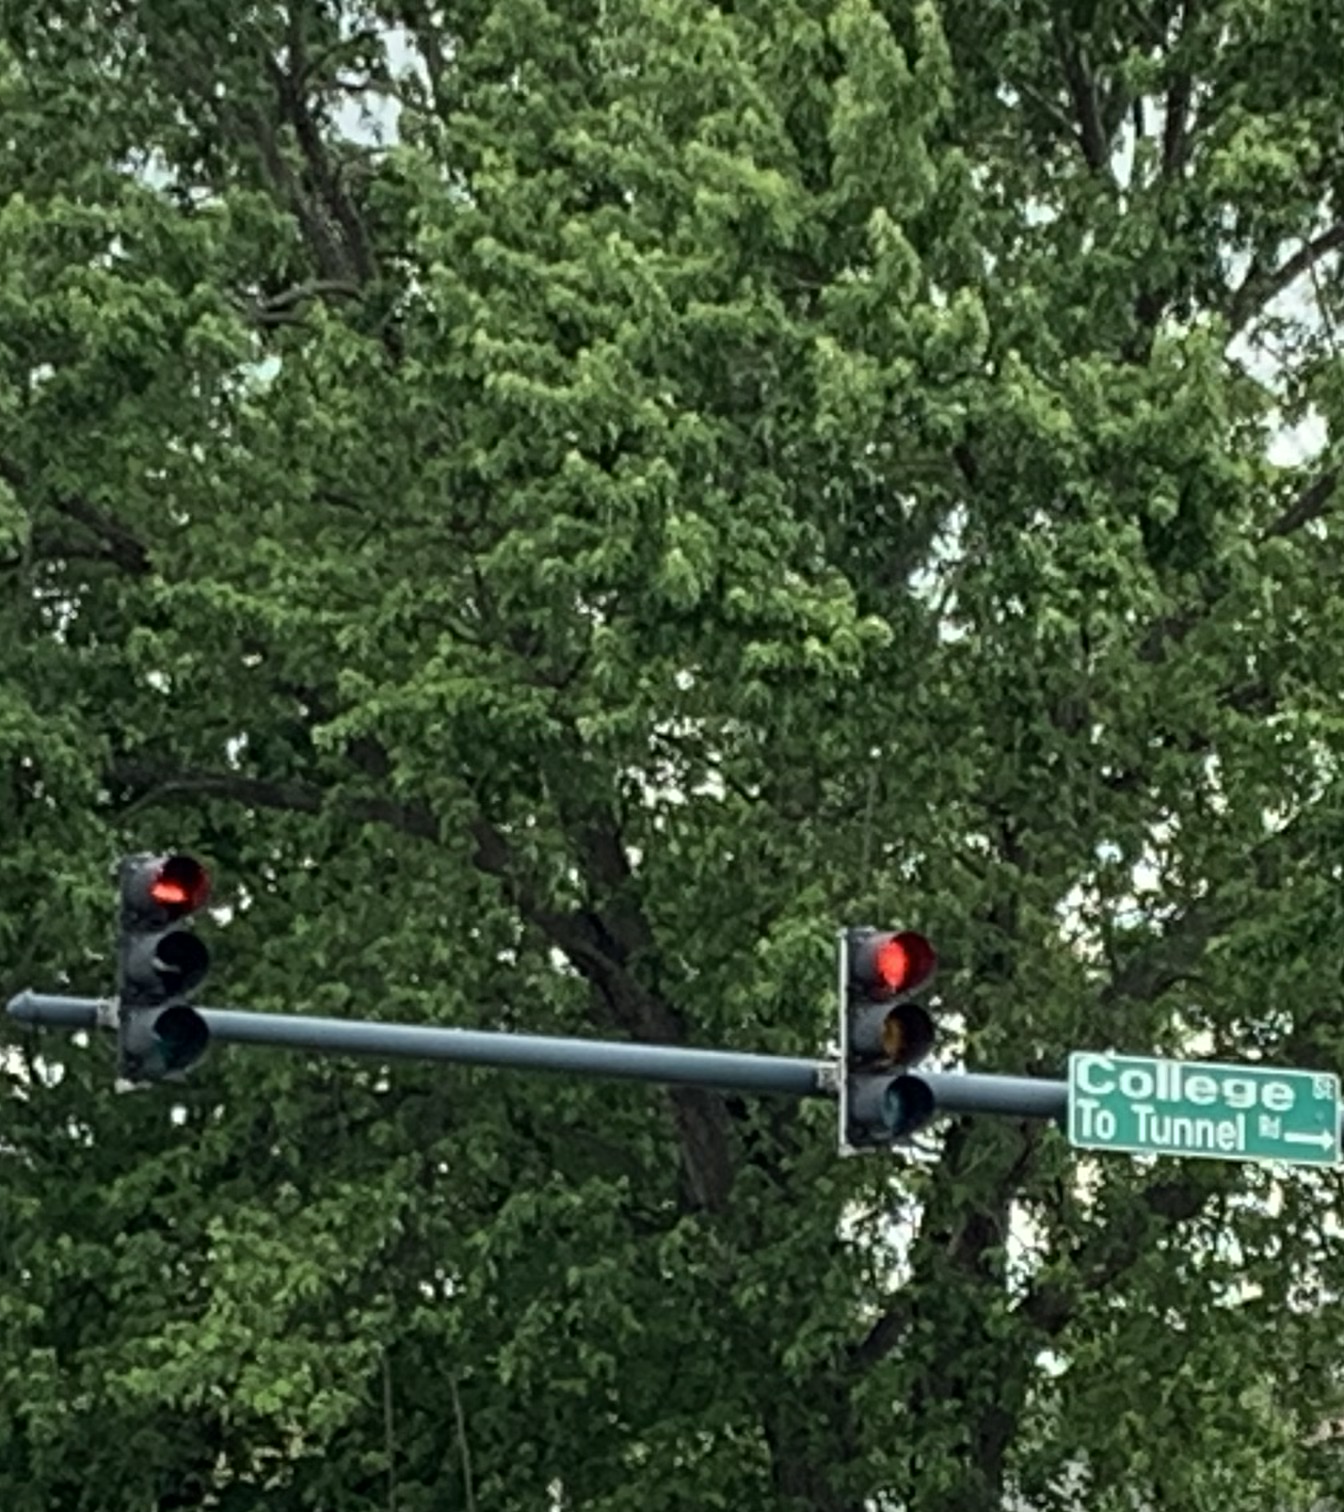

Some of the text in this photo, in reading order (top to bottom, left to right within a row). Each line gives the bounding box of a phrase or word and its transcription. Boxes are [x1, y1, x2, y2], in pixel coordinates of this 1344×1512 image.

[1075, 1055, 1297, 1112] College
[1076, 1098, 1117, 1140] To
[1130, 1103, 1246, 1151] Tunnel
